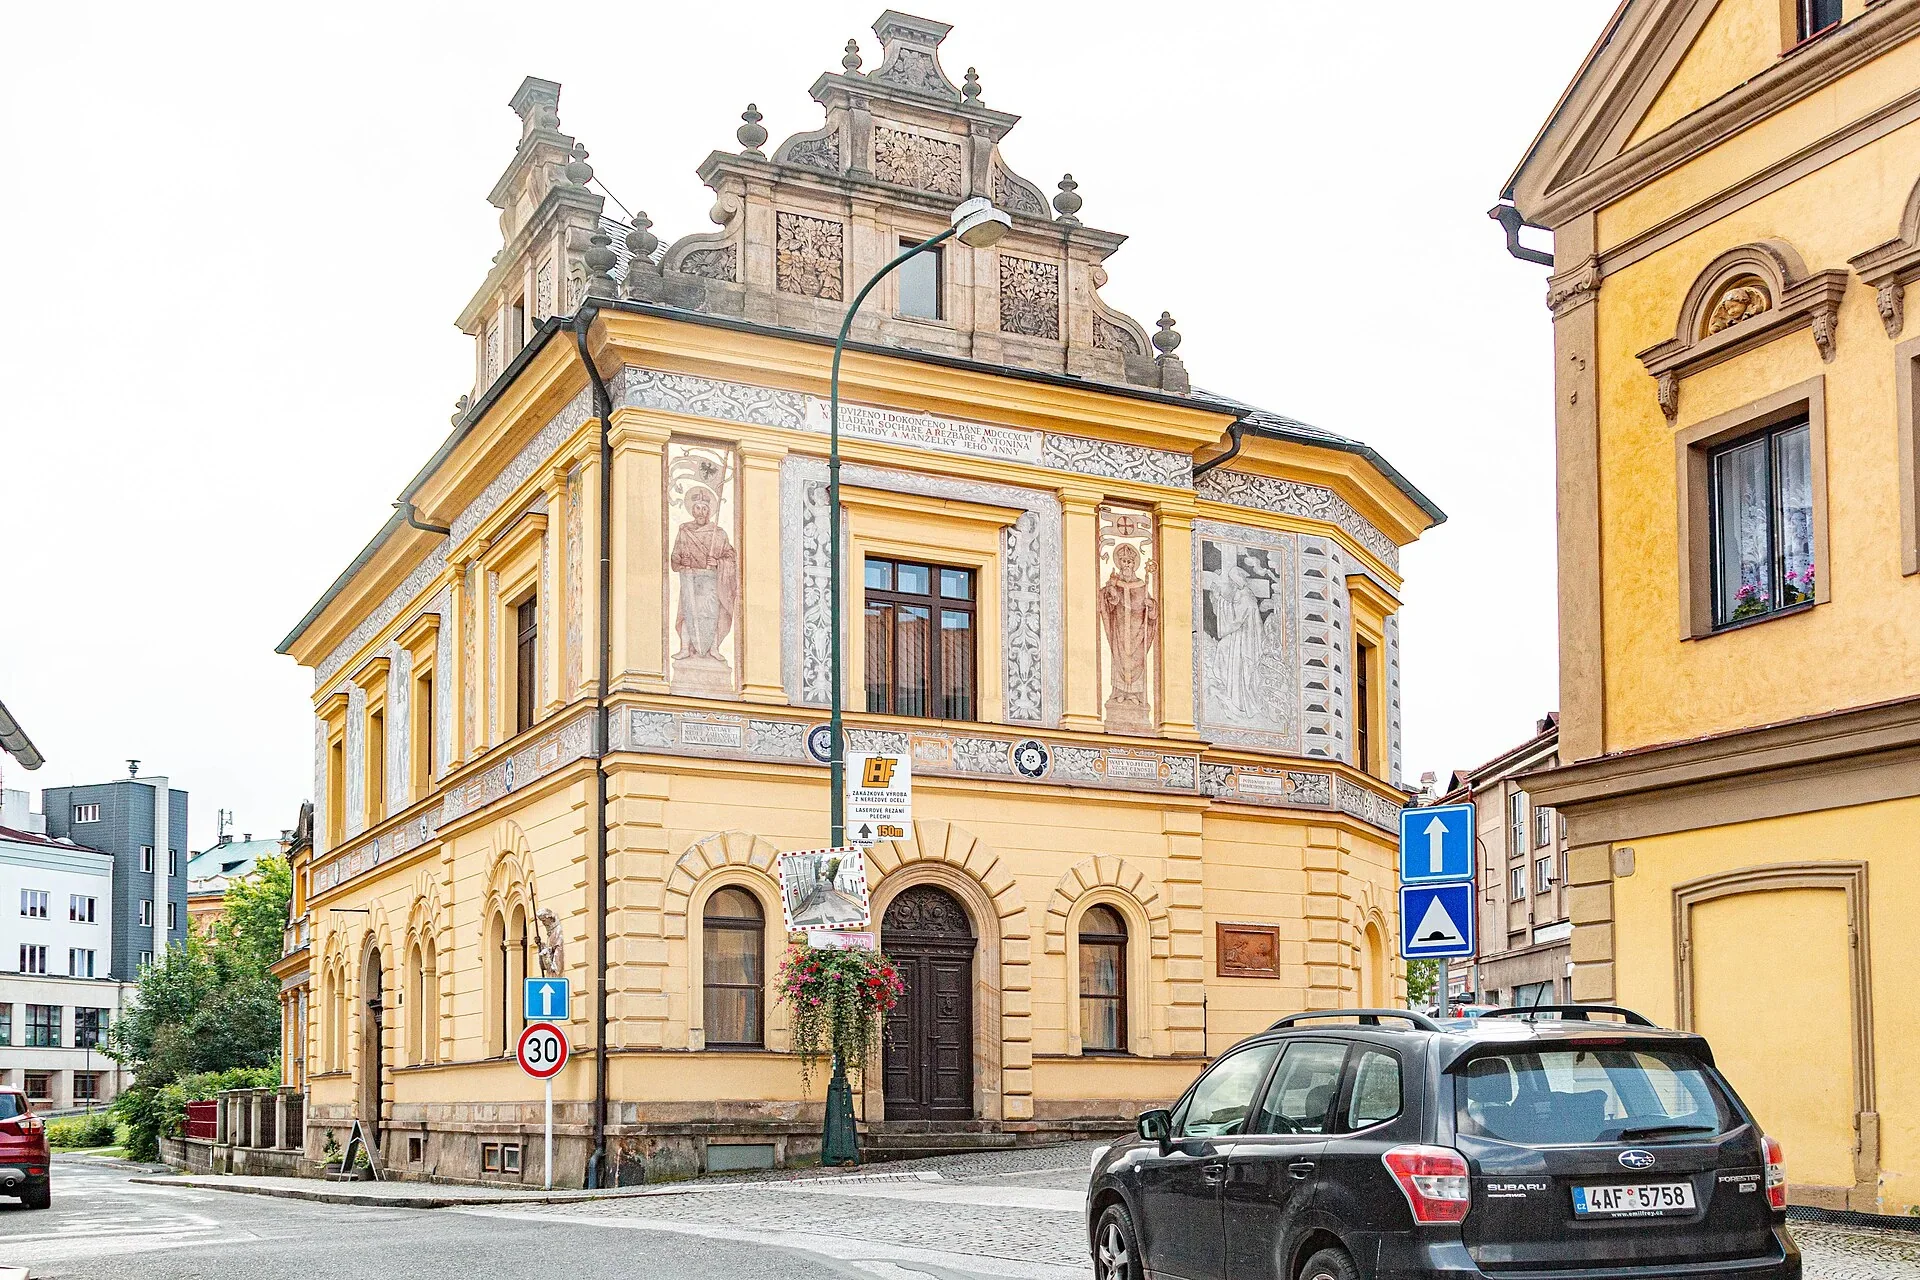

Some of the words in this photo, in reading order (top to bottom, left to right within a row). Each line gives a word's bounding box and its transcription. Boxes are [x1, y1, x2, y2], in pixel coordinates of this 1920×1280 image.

[820, 403, 880, 419] VDVIŽENO
[983, 429, 1032, 443] MDCCCXCVI
[822, 411, 875, 427] NKLADEM
[925, 428, 932, 436] A
[838, 422, 888, 437] UCHARDY
[963, 441, 988, 451] JEHO
[992, 446, 1020, 456] ANNY
[877, 825, 903, 837] 150m
[528, 1037, 558, 1063] 30
[1487, 1183, 1547, 1191] SUBARU
[1718, 1174, 1761, 1183] FORESTER
[1591, 1188, 1623, 1209] 4AF
[1638, 1186, 1685, 1207] 5758
